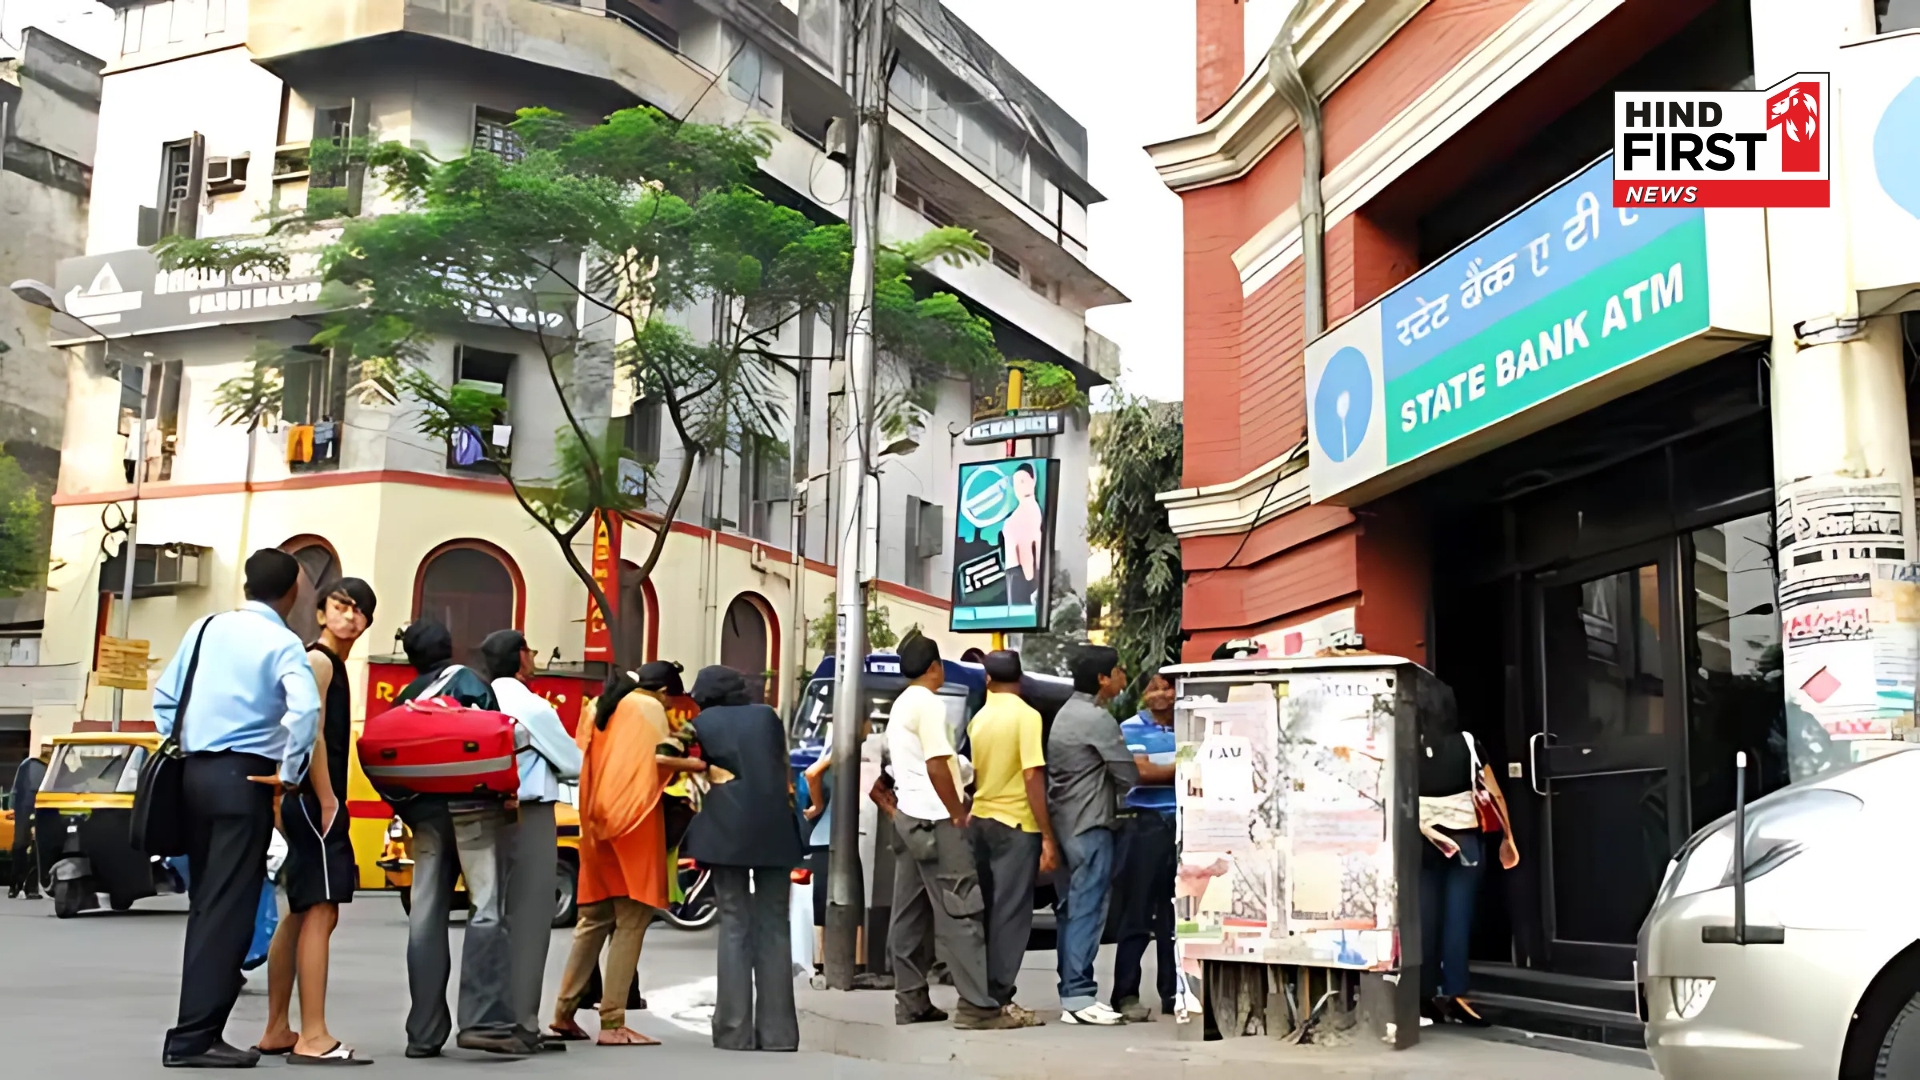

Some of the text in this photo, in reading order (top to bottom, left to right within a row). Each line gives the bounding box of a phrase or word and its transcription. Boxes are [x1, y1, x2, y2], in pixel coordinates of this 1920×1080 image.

[1396, 294, 1449, 346] स्टेट
[1562, 191, 1599, 251] टी
[1401, 262, 1684, 433] STATE BANK ATM
